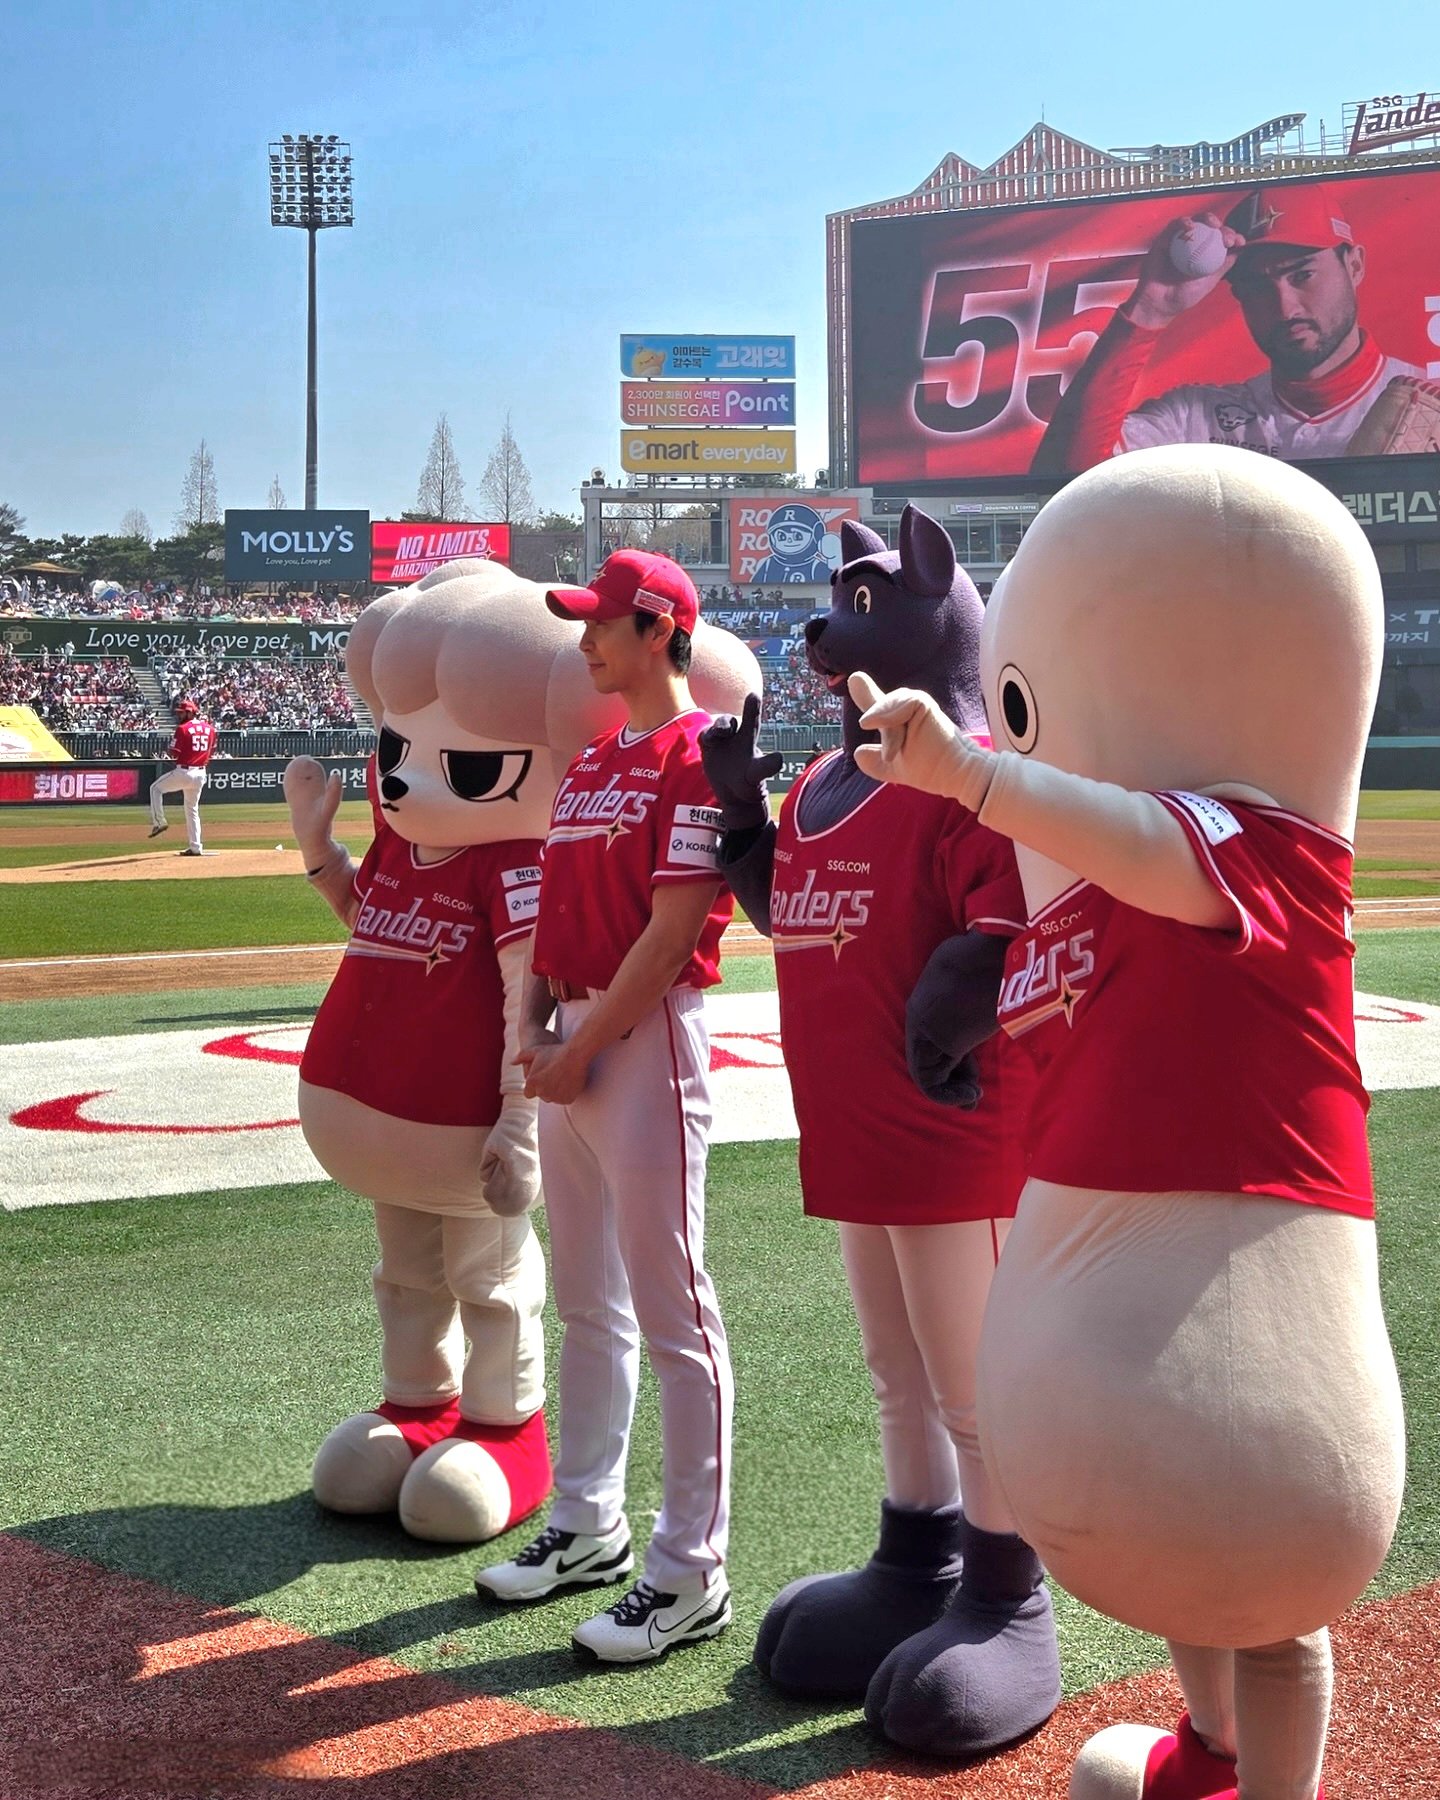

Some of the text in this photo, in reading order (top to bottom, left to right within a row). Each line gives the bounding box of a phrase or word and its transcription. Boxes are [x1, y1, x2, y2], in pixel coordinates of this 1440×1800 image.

[1372, 95, 1403, 109] SSG
[912, 250, 1149, 435] 55
[716, 345, 787, 369] 고래잇
[627, 390, 789, 417] SHINSEGAE Point
[628, 439, 788, 464] emart everyday
[1342, 491, 1440, 525] 랜더스
[395, 529, 490, 561] NO LIMITS
[265, 557, 283, 565] Love
[300, 557, 318, 565] Love
[318, 557, 332, 567] pet
[86, 627, 140, 648] Love
[198, 629, 249, 651] Love
[251, 633, 291, 654] pet
[191, 735, 209, 752] 55
[33, 773, 108, 799] 화이트
[826, 859, 871, 875] SSG.COM
[431, 892, 475, 914] SSG.COM
